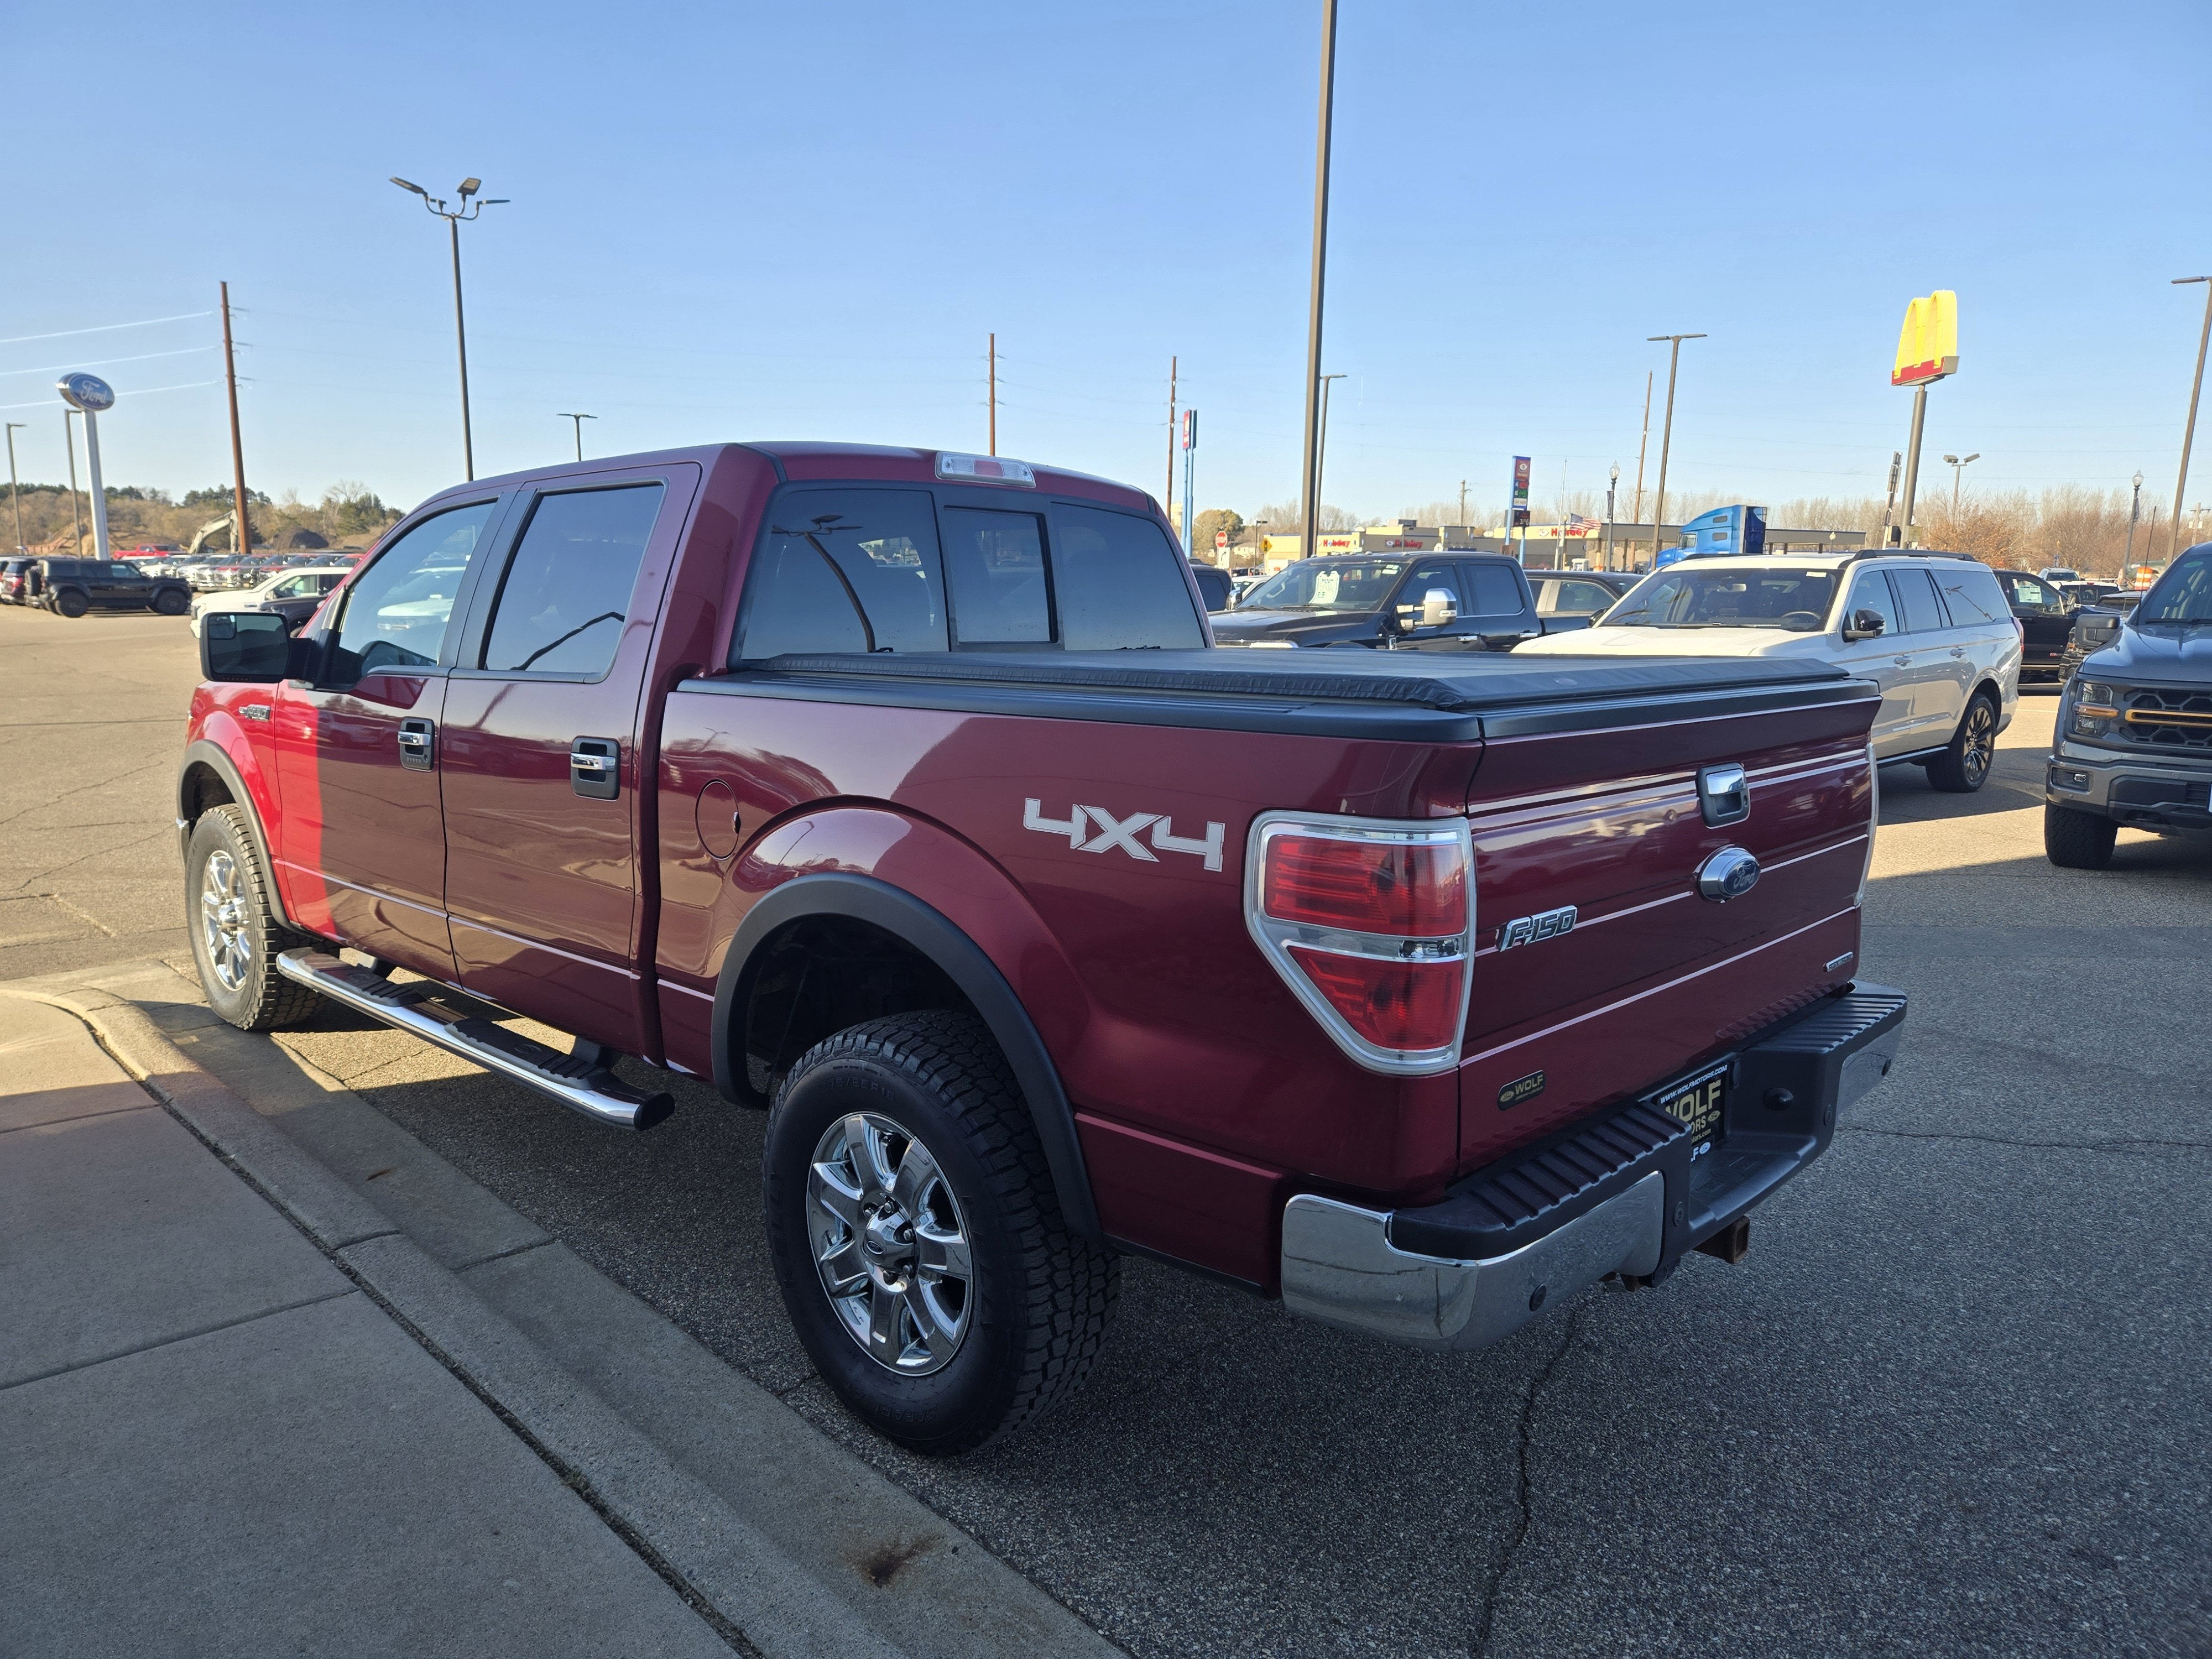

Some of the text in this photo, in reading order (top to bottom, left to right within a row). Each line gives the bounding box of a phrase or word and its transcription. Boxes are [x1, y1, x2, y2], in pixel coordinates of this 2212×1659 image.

[80, 380, 108, 404] Ford
[1323, 539, 1350, 548] Holiday
[1733, 864, 1757, 889] Ford
[1500, 905, 1577, 952] F-150
[1515, 1074, 1543, 1095] WOLF
[1660, 1064, 1728, 1104] WWW.WOLFMOTORS.COM
